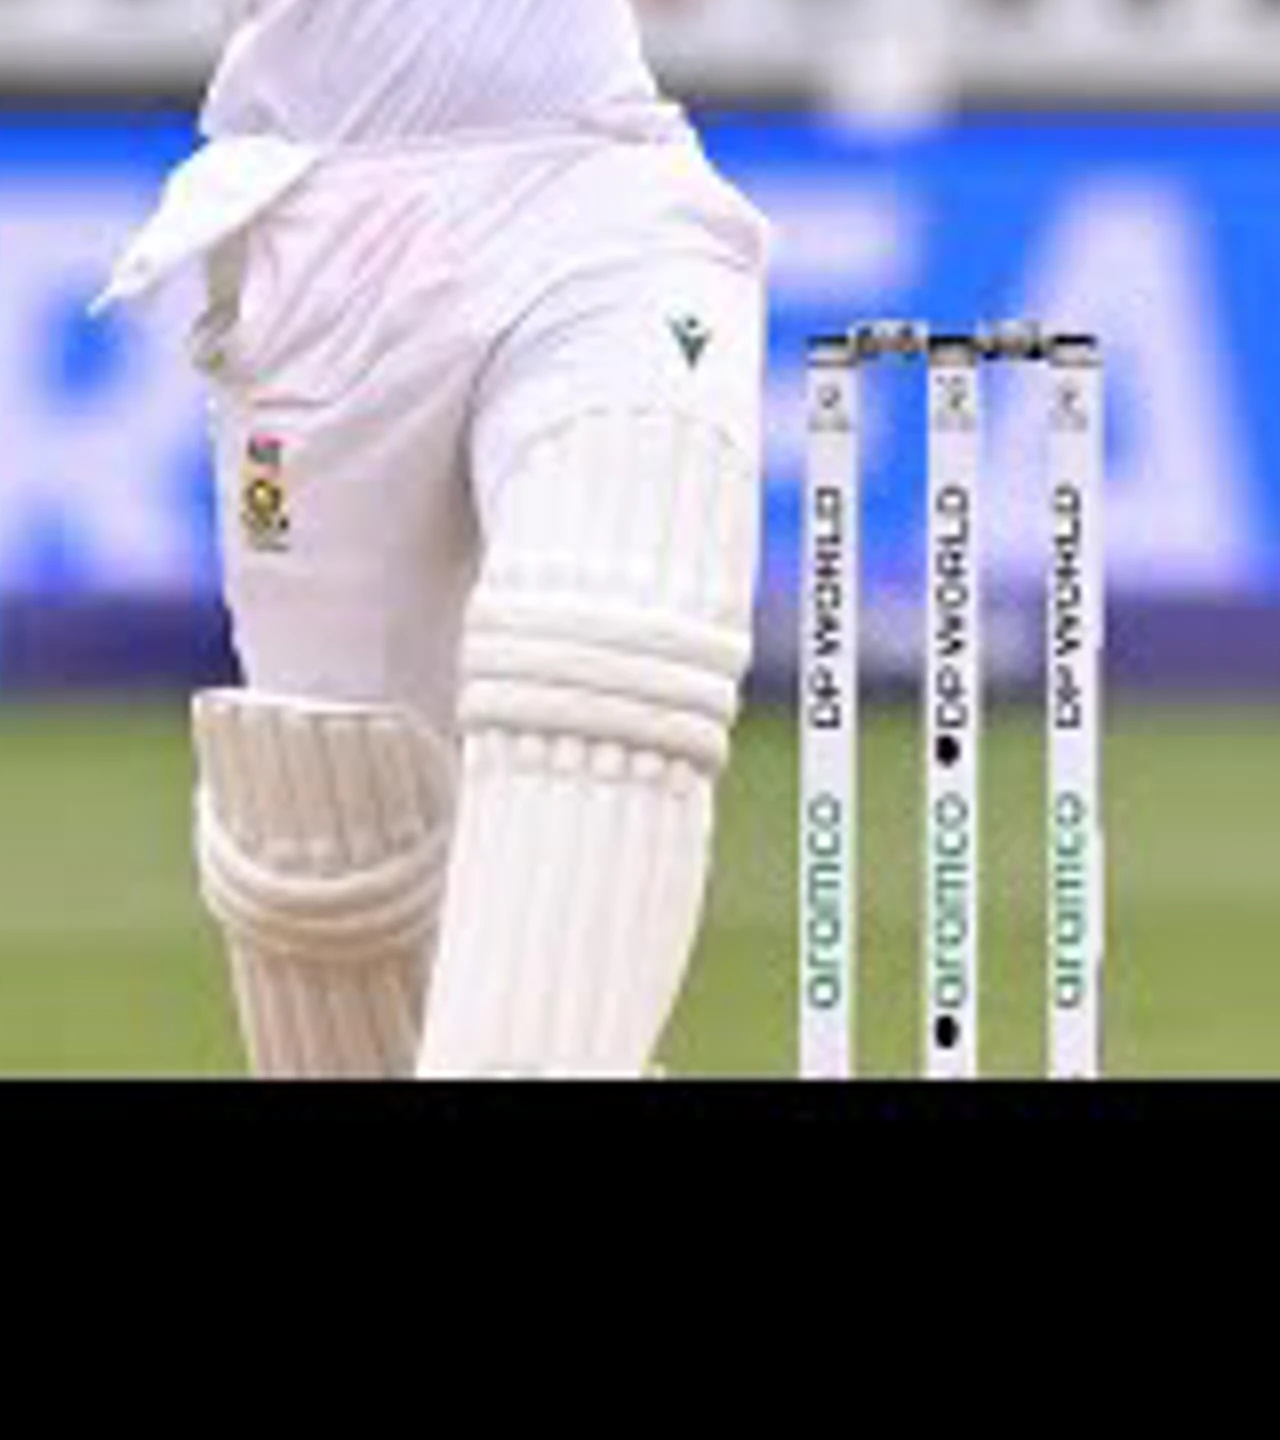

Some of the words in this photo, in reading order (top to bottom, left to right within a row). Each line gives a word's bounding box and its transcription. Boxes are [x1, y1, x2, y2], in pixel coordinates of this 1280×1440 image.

[813, 485, 842, 657] WORLD
[934, 484, 970, 657] WORLD
[1054, 483, 1082, 657] WORLD
[809, 664, 842, 730] DP
[935, 663, 969, 730] DP
[1054, 664, 1082, 730] DP
[807, 791, 842, 1010] aramco
[935, 791, 969, 1010] aramco
[1055, 791, 1084, 1010] aramco
